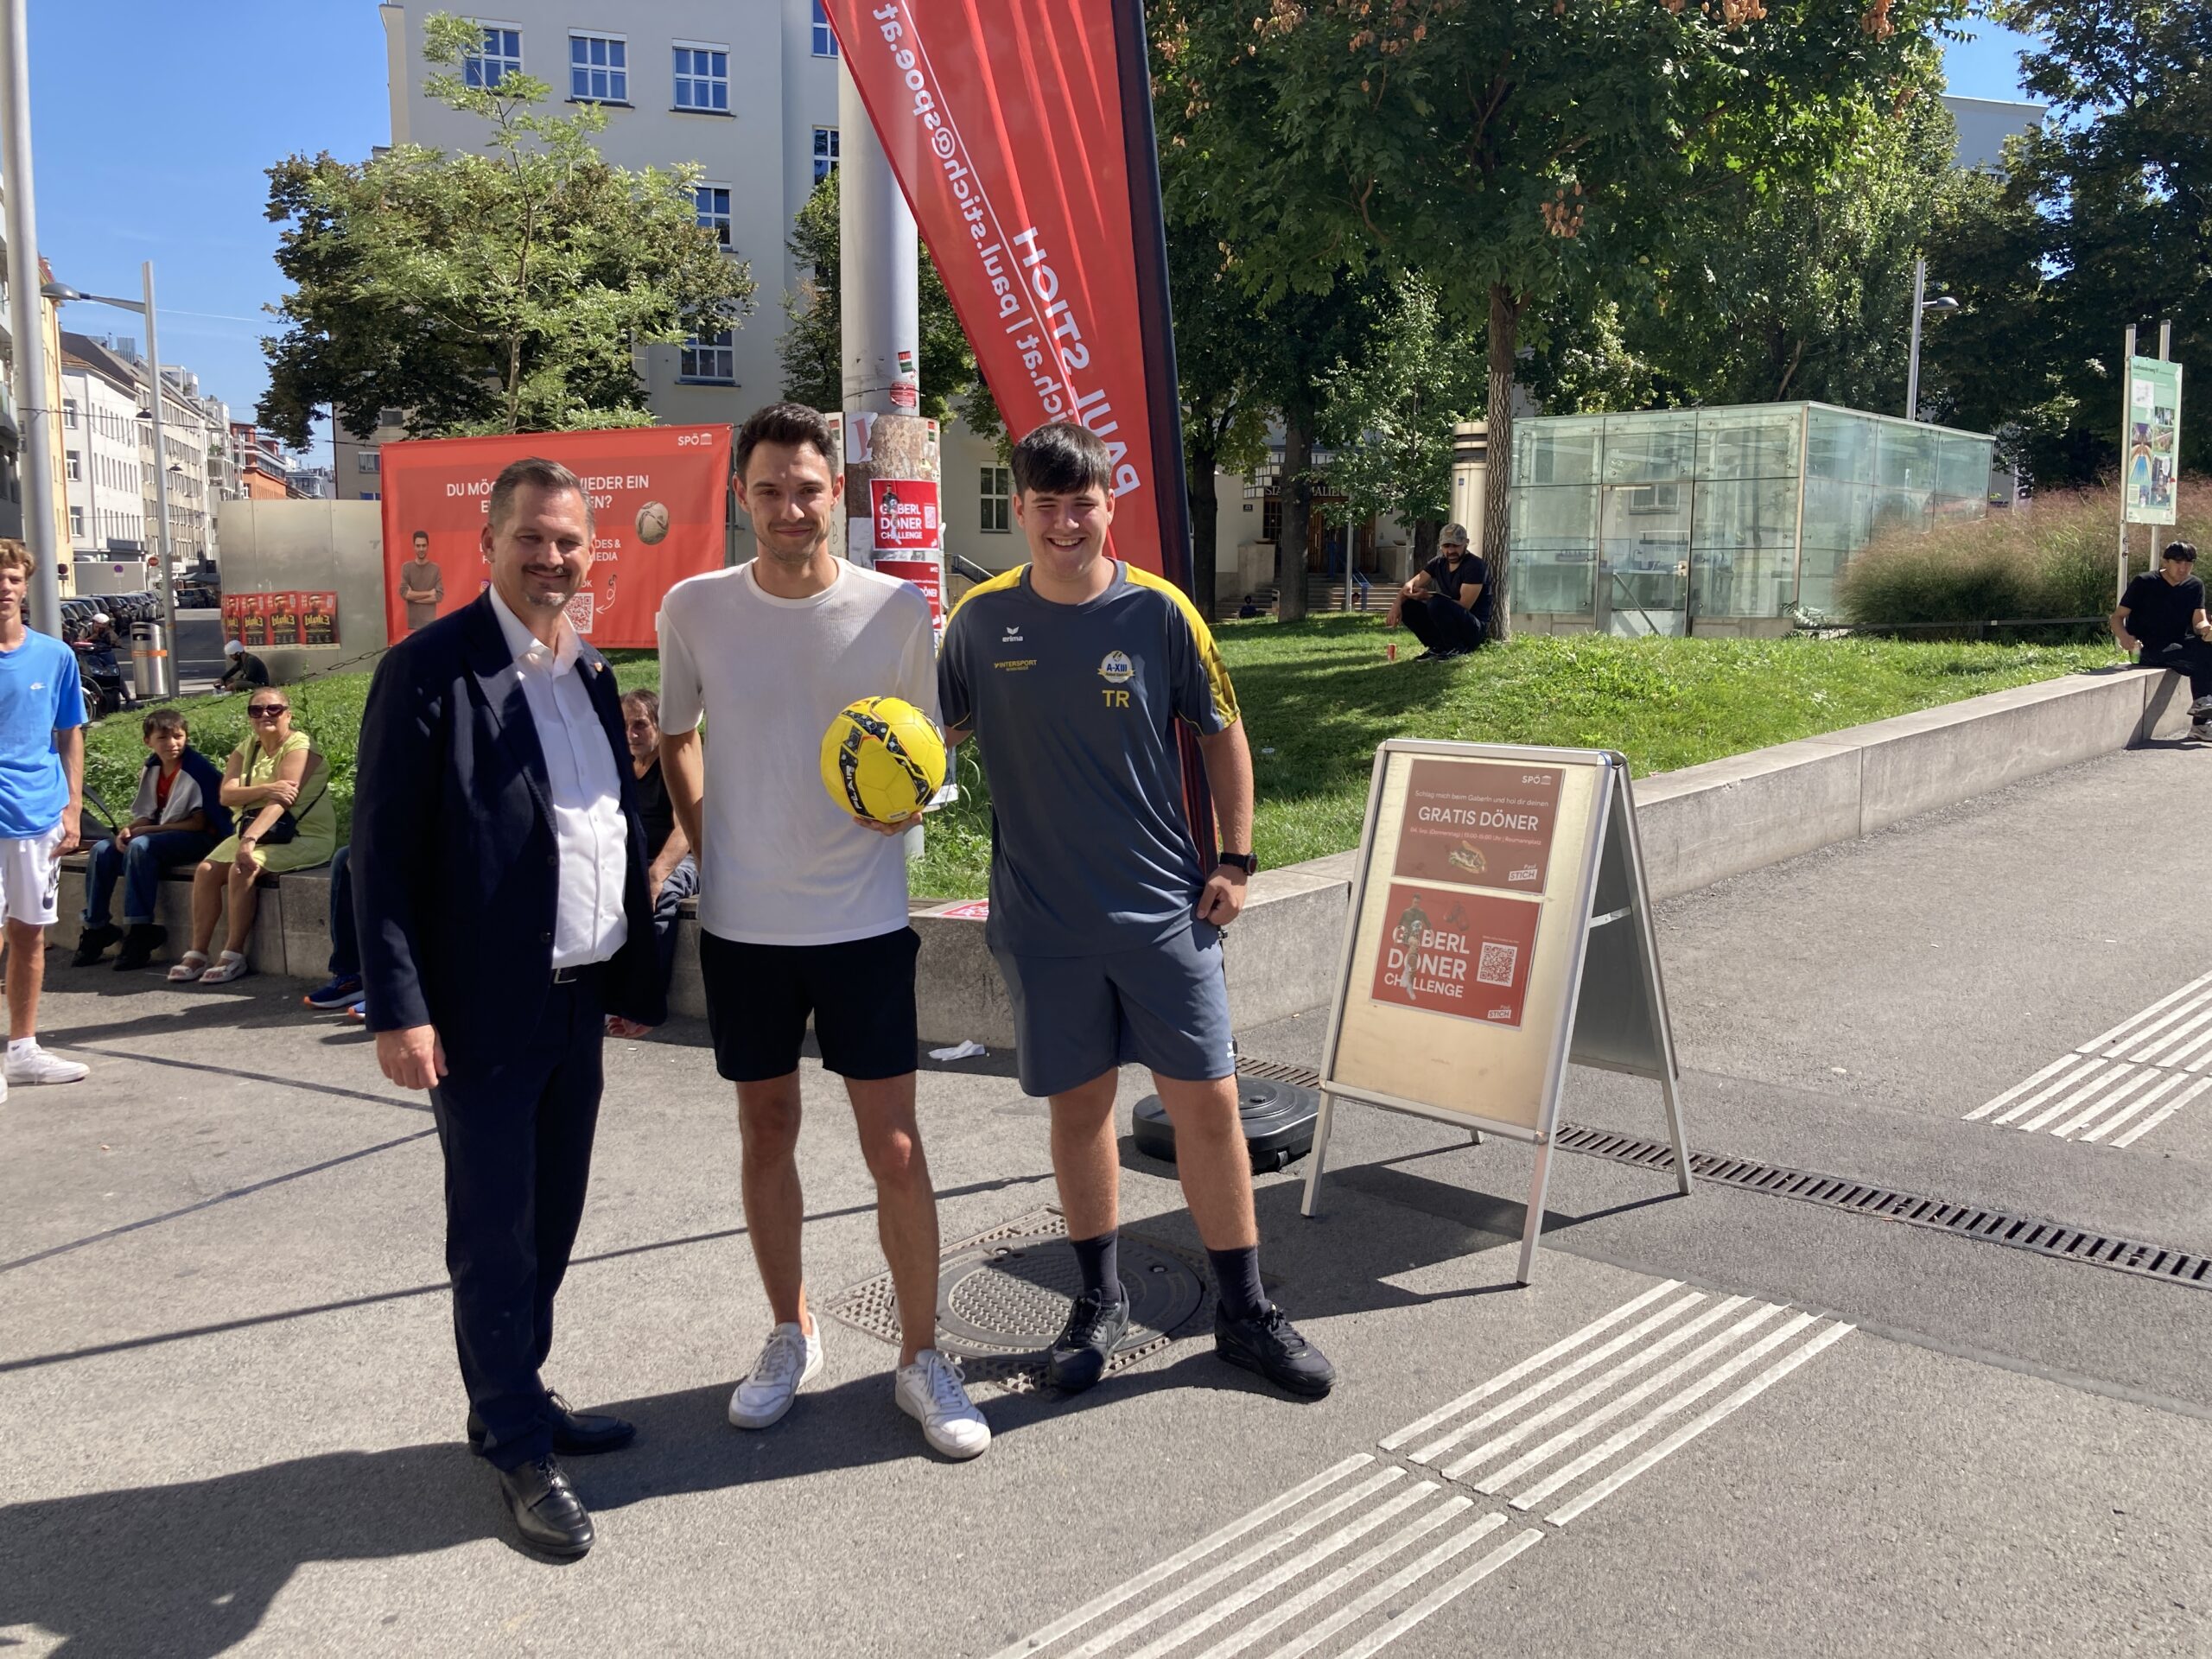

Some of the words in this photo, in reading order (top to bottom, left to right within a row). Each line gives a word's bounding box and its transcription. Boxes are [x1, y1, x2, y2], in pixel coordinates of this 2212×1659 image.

[626, 475, 649, 489] EIN
[447, 483, 464, 496] DU
[880, 503, 921, 515] GBERL
[999, 660, 1037, 669] INTERSPORT
[1102, 690, 1129, 708] TR
[1418, 806, 1477, 825] GRATIS
[1479, 809, 1539, 831] DÖNER
[1510, 871, 1535, 880] STICH
[1392, 925, 1470, 954] GBERL
[1384, 973, 1464, 998] CHLLENGE
